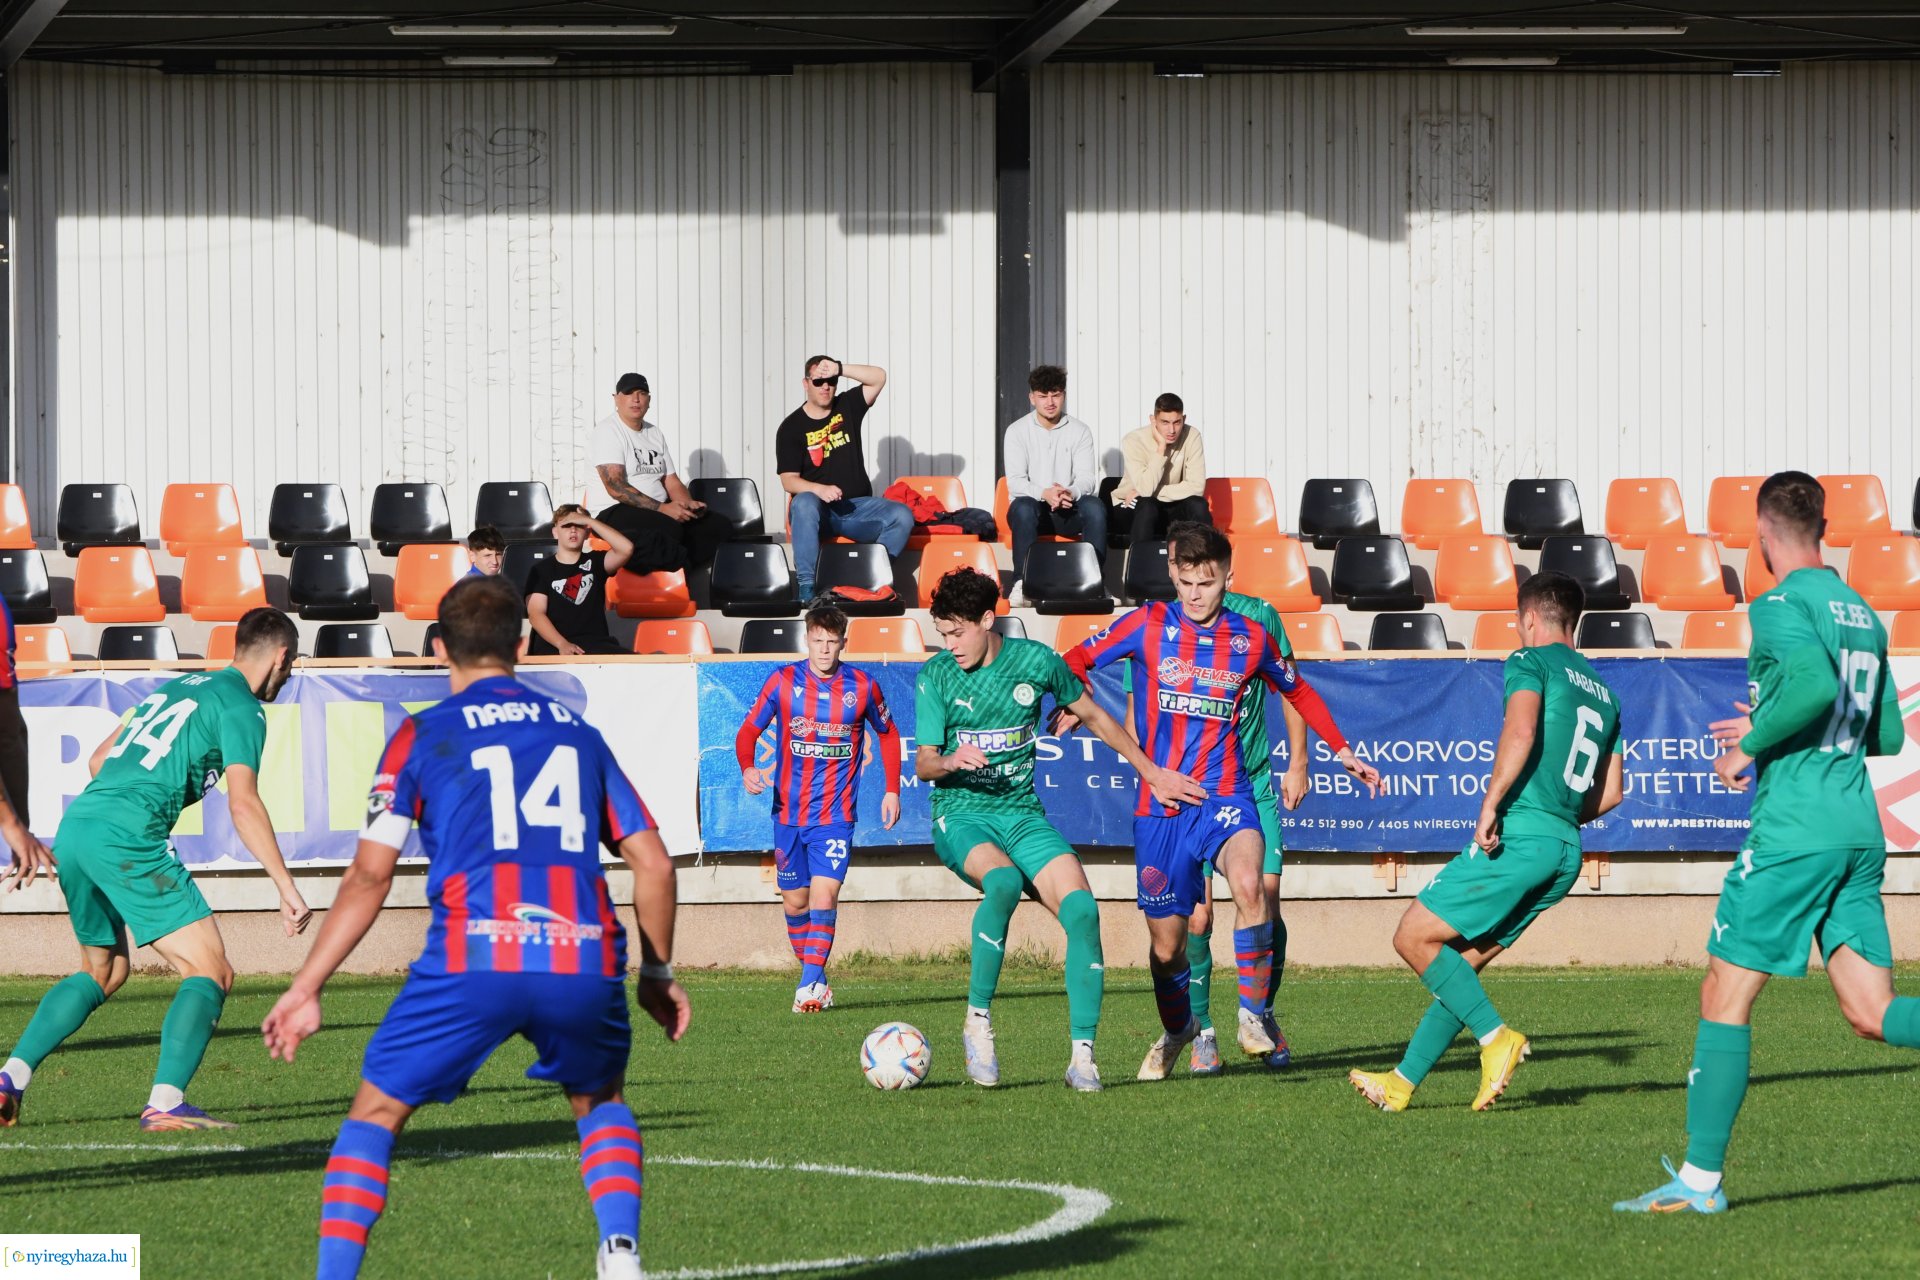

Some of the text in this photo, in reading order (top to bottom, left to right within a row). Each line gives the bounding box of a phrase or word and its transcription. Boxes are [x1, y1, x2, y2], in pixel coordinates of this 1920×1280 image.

[1190, 666, 1245, 684] REVESZ
[461, 701, 580, 730] NAGY D.
[104, 692, 199, 771] 34
[1562, 704, 1604, 794] 6
[470, 744, 587, 853] 14
[1273, 772, 1360, 798] TBB,
[1280, 817, 1296, 828] 36
[1299, 818, 1314, 829] 42
[1318, 818, 1337, 829] 512
[1340, 819, 1364, 830] 990
[1378, 820, 1410, 830] 4405
[1592, 818, 1609, 829] 16.
[825, 838, 847, 859] 23
